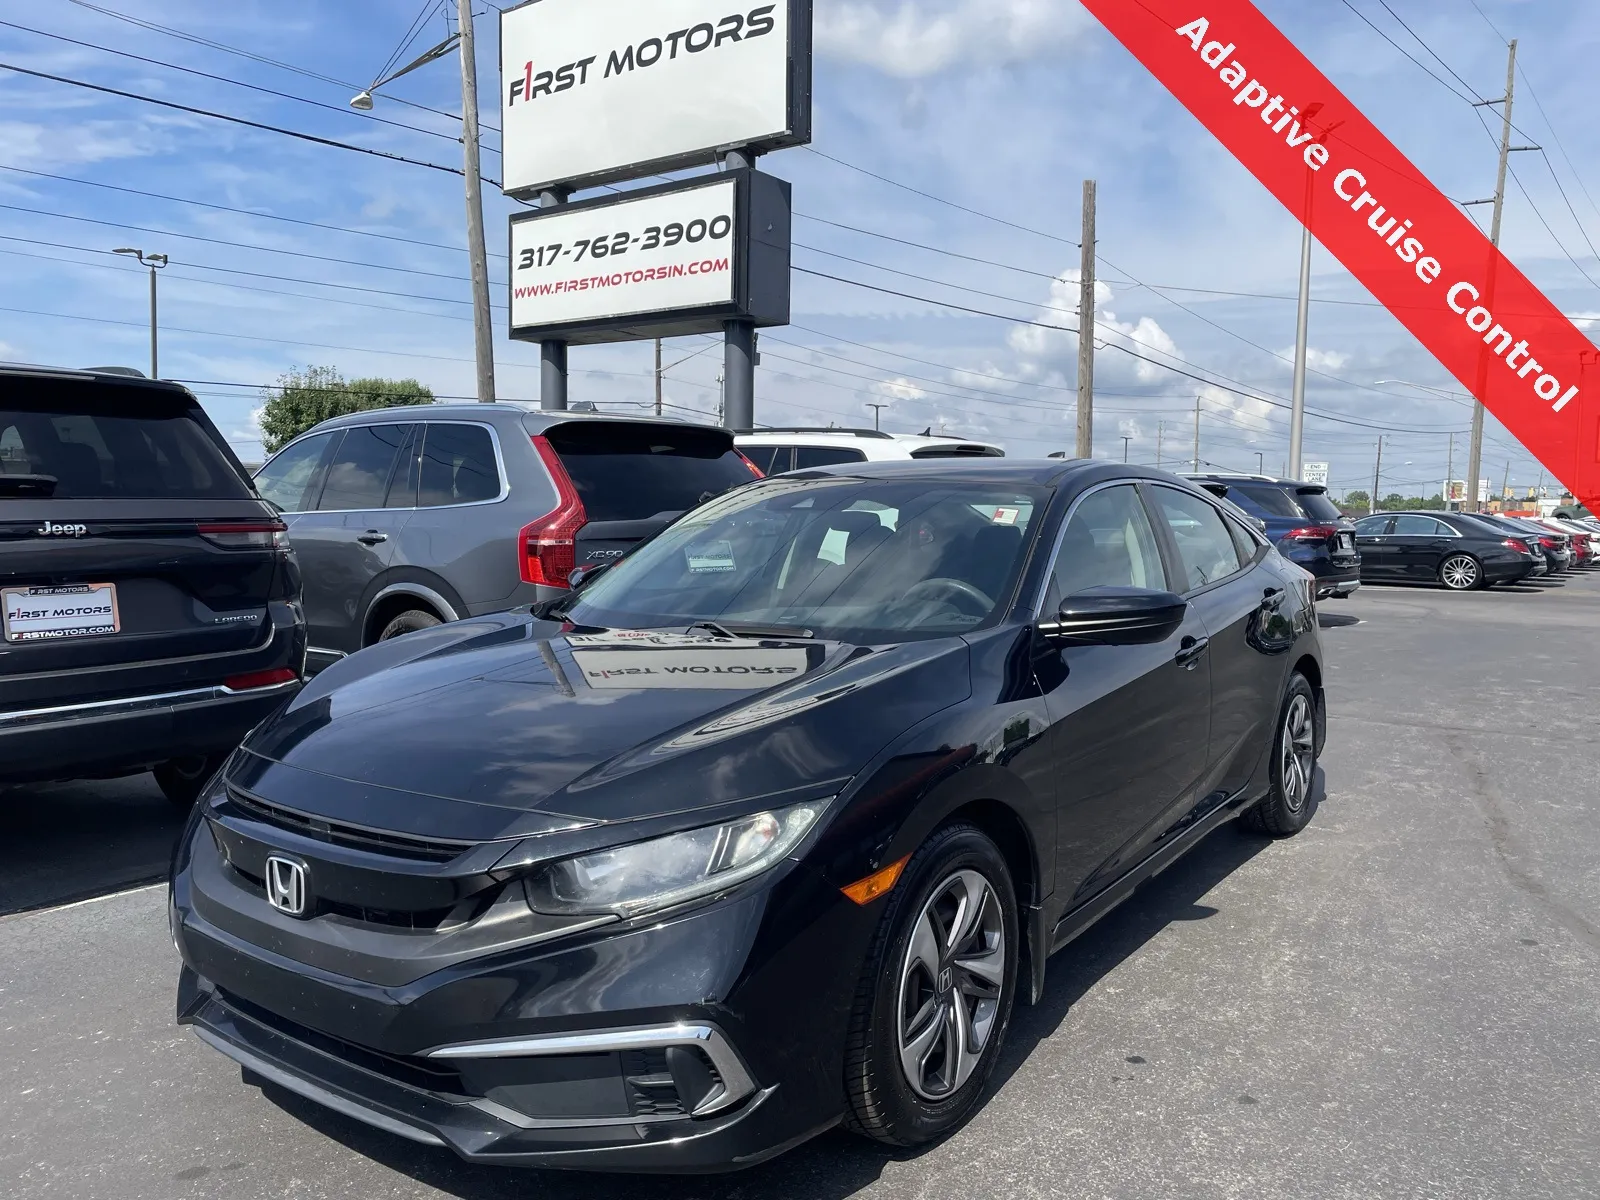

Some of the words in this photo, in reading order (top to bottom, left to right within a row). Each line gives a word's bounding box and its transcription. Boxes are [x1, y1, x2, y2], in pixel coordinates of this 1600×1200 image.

[603, 4, 777, 79] MOTORS
[517, 214, 732, 271] 317-762-3900
[514, 257, 729, 299] WWW.FIRSTMOTORSIN.COM
[37, 521, 87, 538] Jeep
[586, 550, 624, 560] XC90
[54, 586, 88, 594] MOTORS
[52, 605, 112, 617] MOTORS
